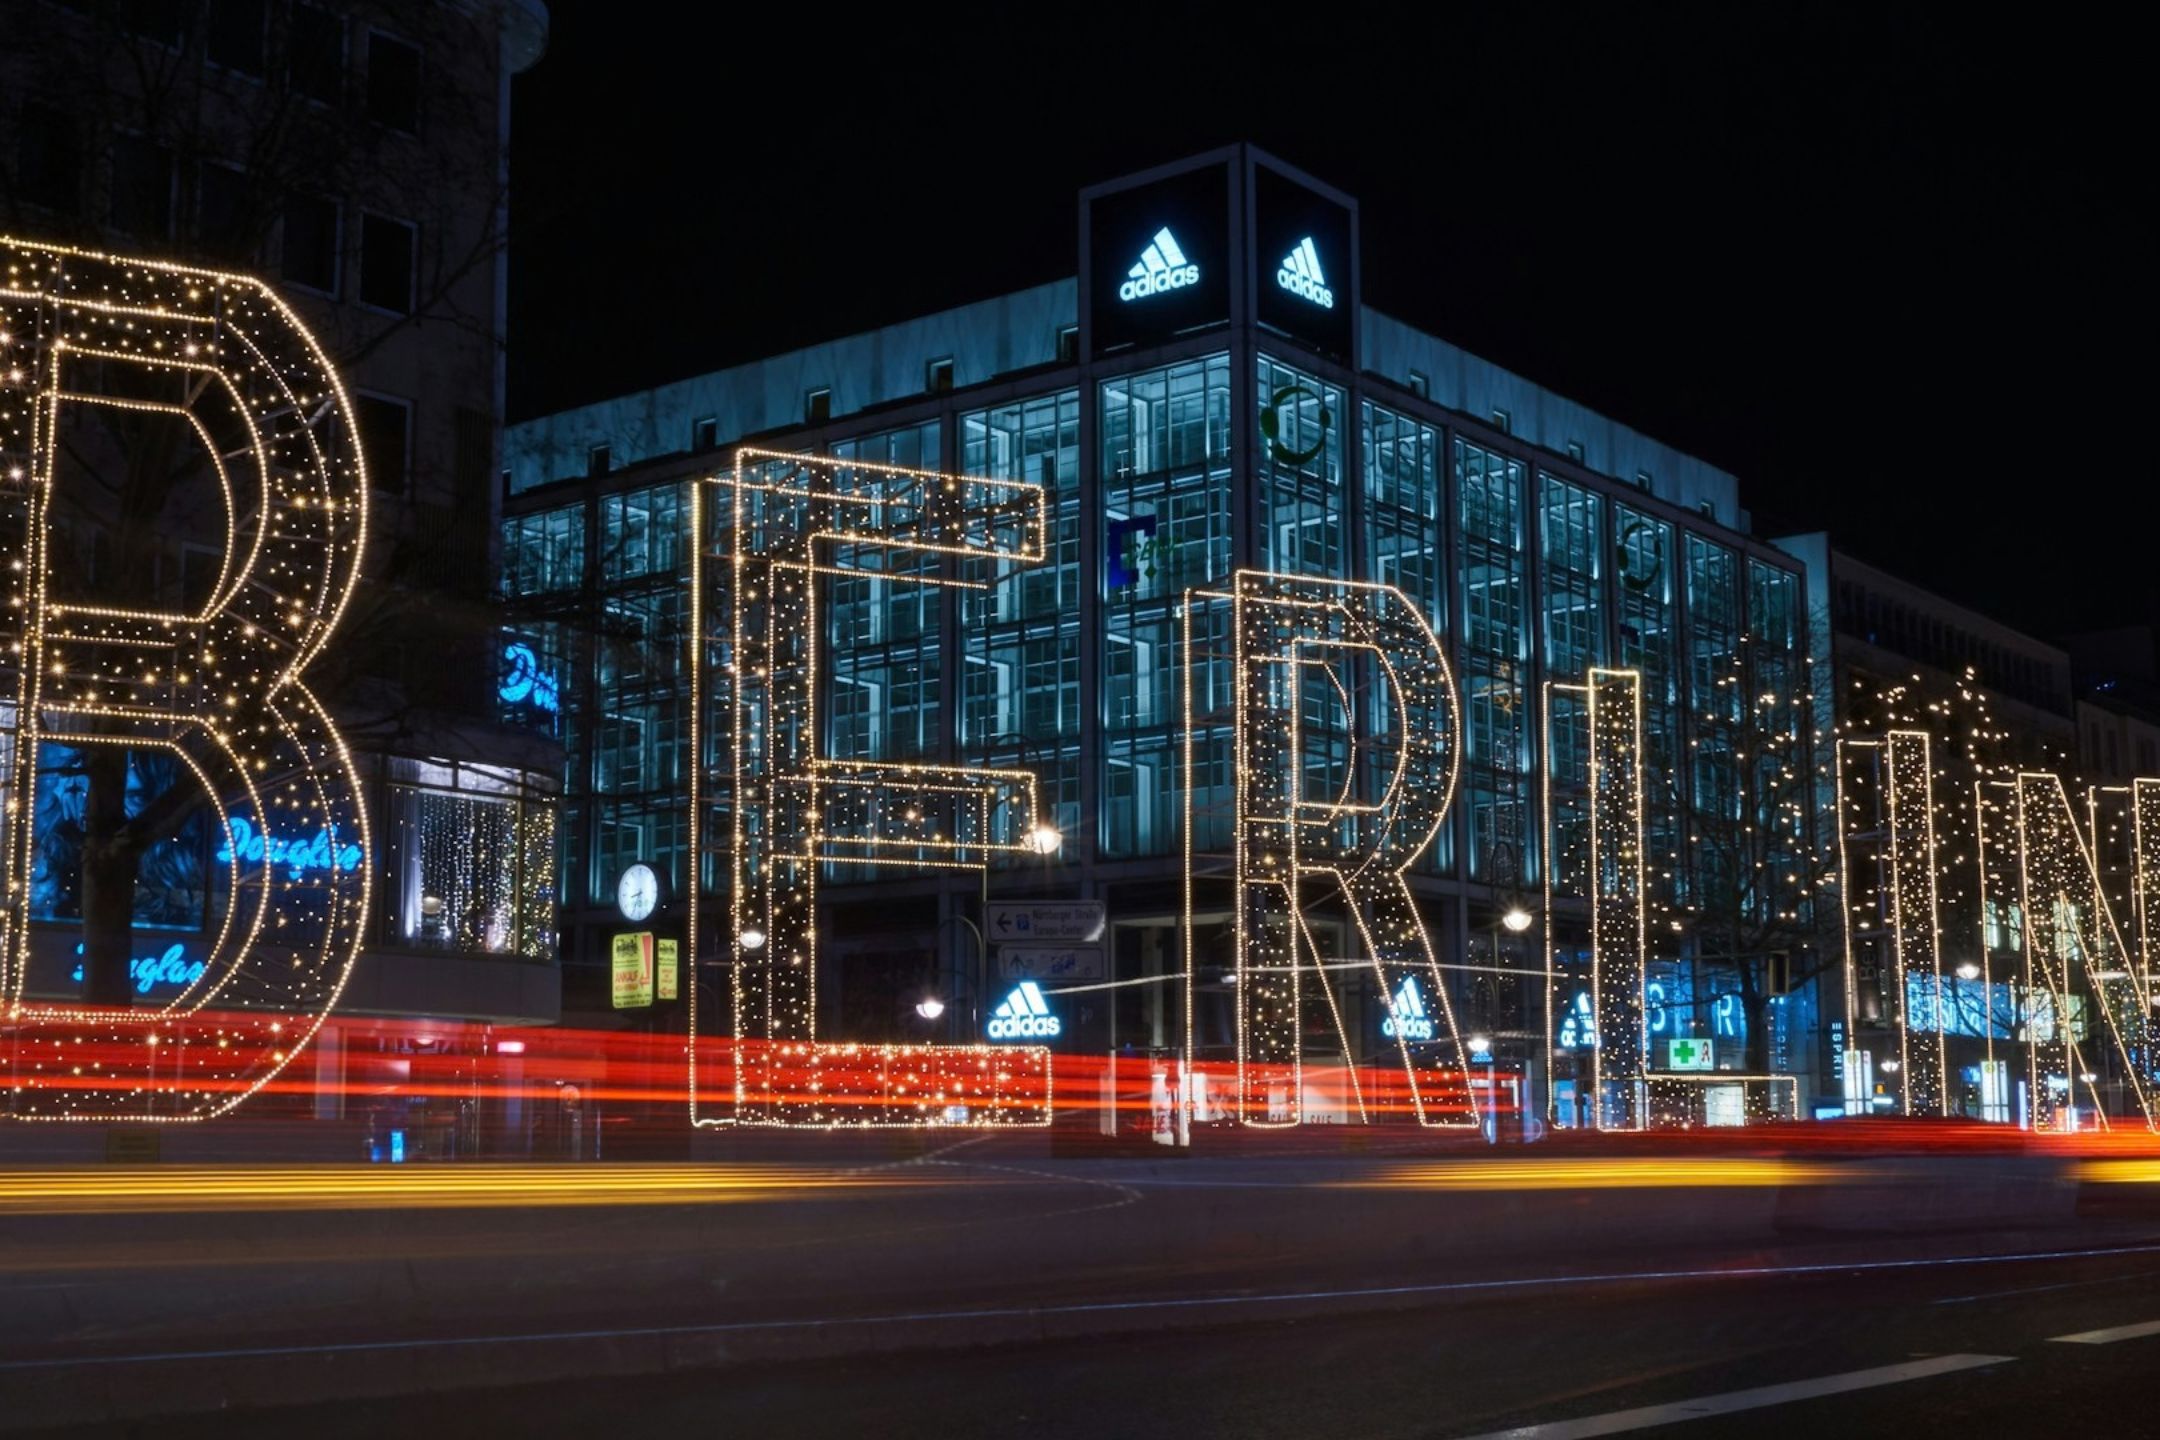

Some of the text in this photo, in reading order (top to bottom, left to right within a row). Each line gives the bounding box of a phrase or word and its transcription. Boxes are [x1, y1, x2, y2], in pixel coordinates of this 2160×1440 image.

[1119, 264, 1200, 301] adidas
[1277, 268, 1334, 309] adidas
[216, 816, 363, 880] Douglas
[987, 1014, 1061, 1038] adidas
[1831, 1022, 1844, 1080] ESPRIT
